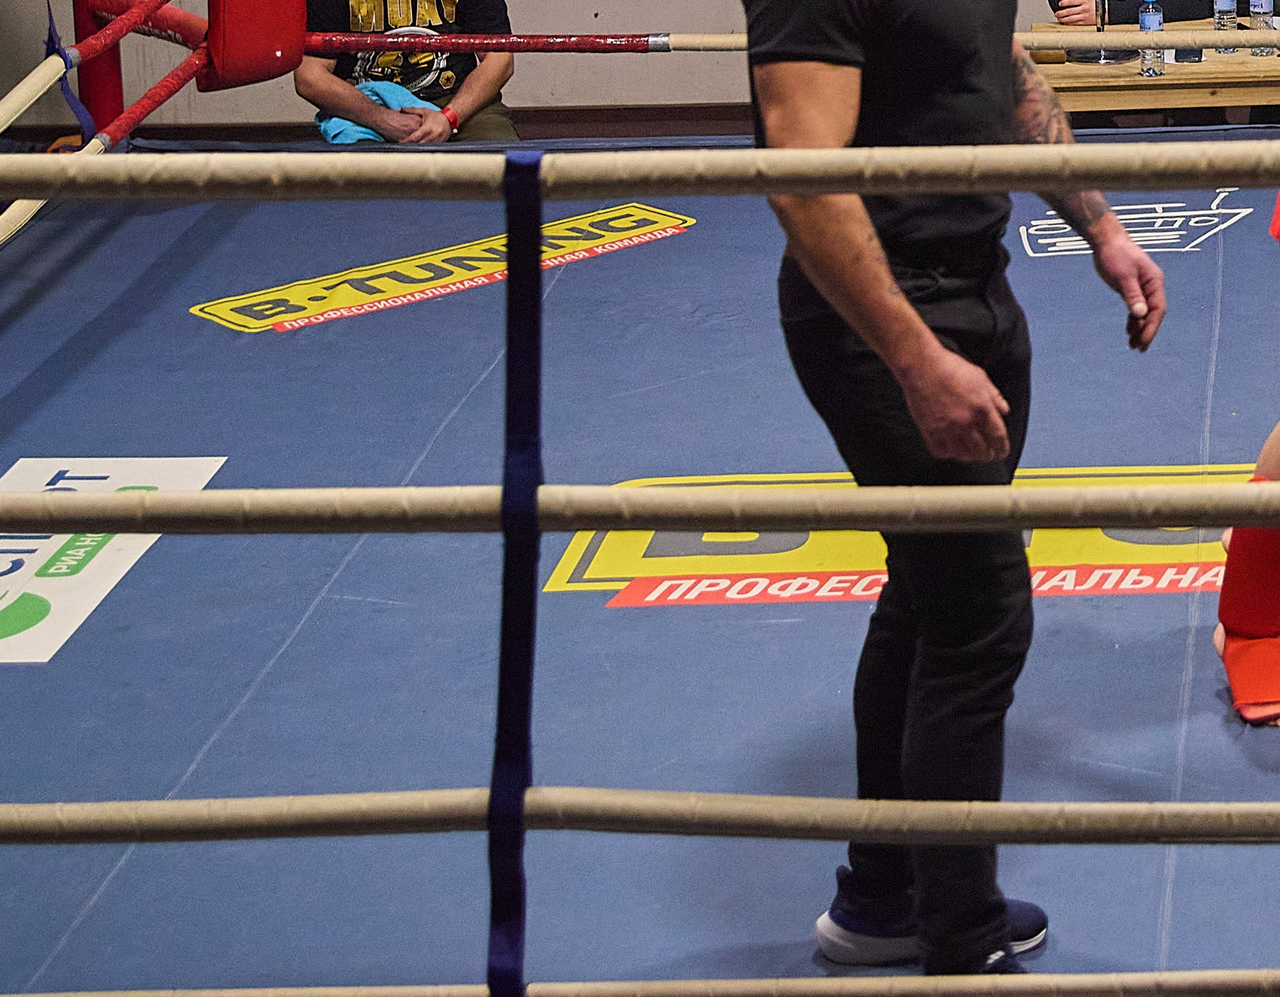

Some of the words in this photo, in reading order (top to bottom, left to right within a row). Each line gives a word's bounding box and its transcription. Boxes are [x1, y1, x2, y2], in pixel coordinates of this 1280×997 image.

[283, 276, 488, 331] ПРОФЕССИОНАЛЬНАЯ
[593, 226, 680, 255] КОМАНДА
[47, 547, 88, 575] РИА
